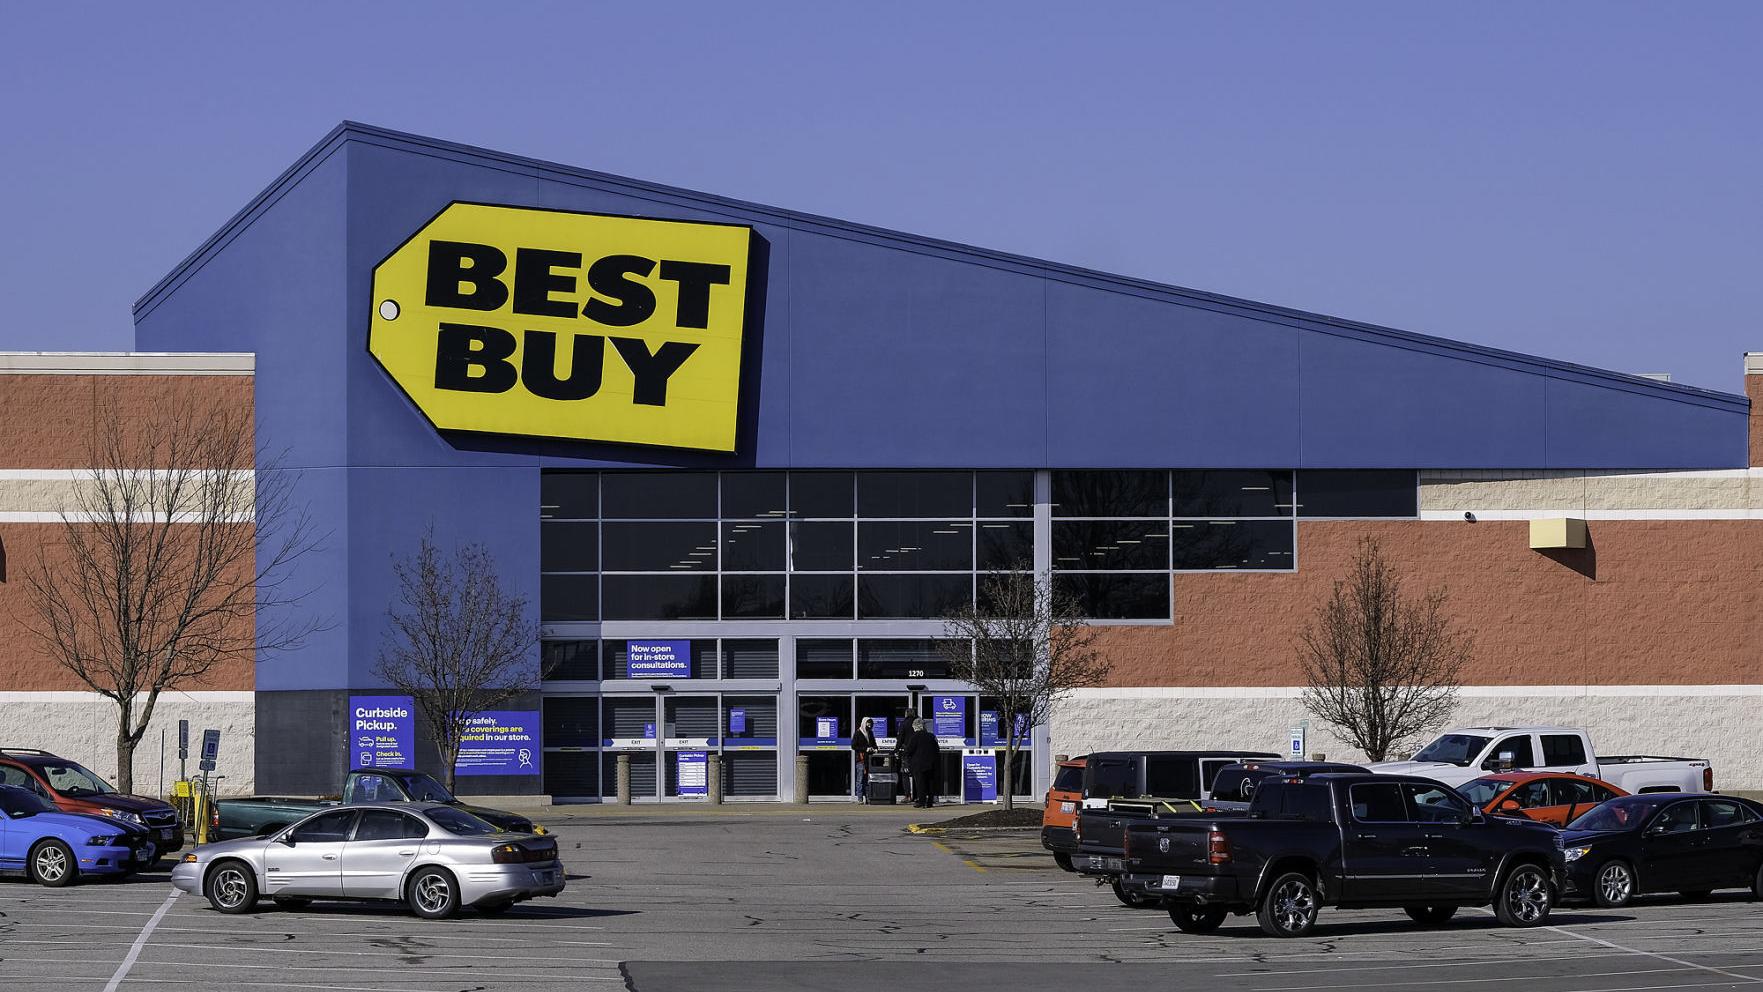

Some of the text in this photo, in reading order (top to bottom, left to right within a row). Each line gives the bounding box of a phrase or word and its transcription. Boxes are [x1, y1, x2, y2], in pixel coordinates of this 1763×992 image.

[425, 239, 731, 329] BEST
[434, 322, 702, 407] BUY
[631, 645, 650, 653] Now
[631, 653, 675, 661] for in-store
[631, 661, 687, 669] consultations.
[355, 707, 408, 718] Curbside
[472, 717, 497, 725] safely.
[356, 719, 397, 732] Pickup.
[470, 726, 509, 734] coverings
